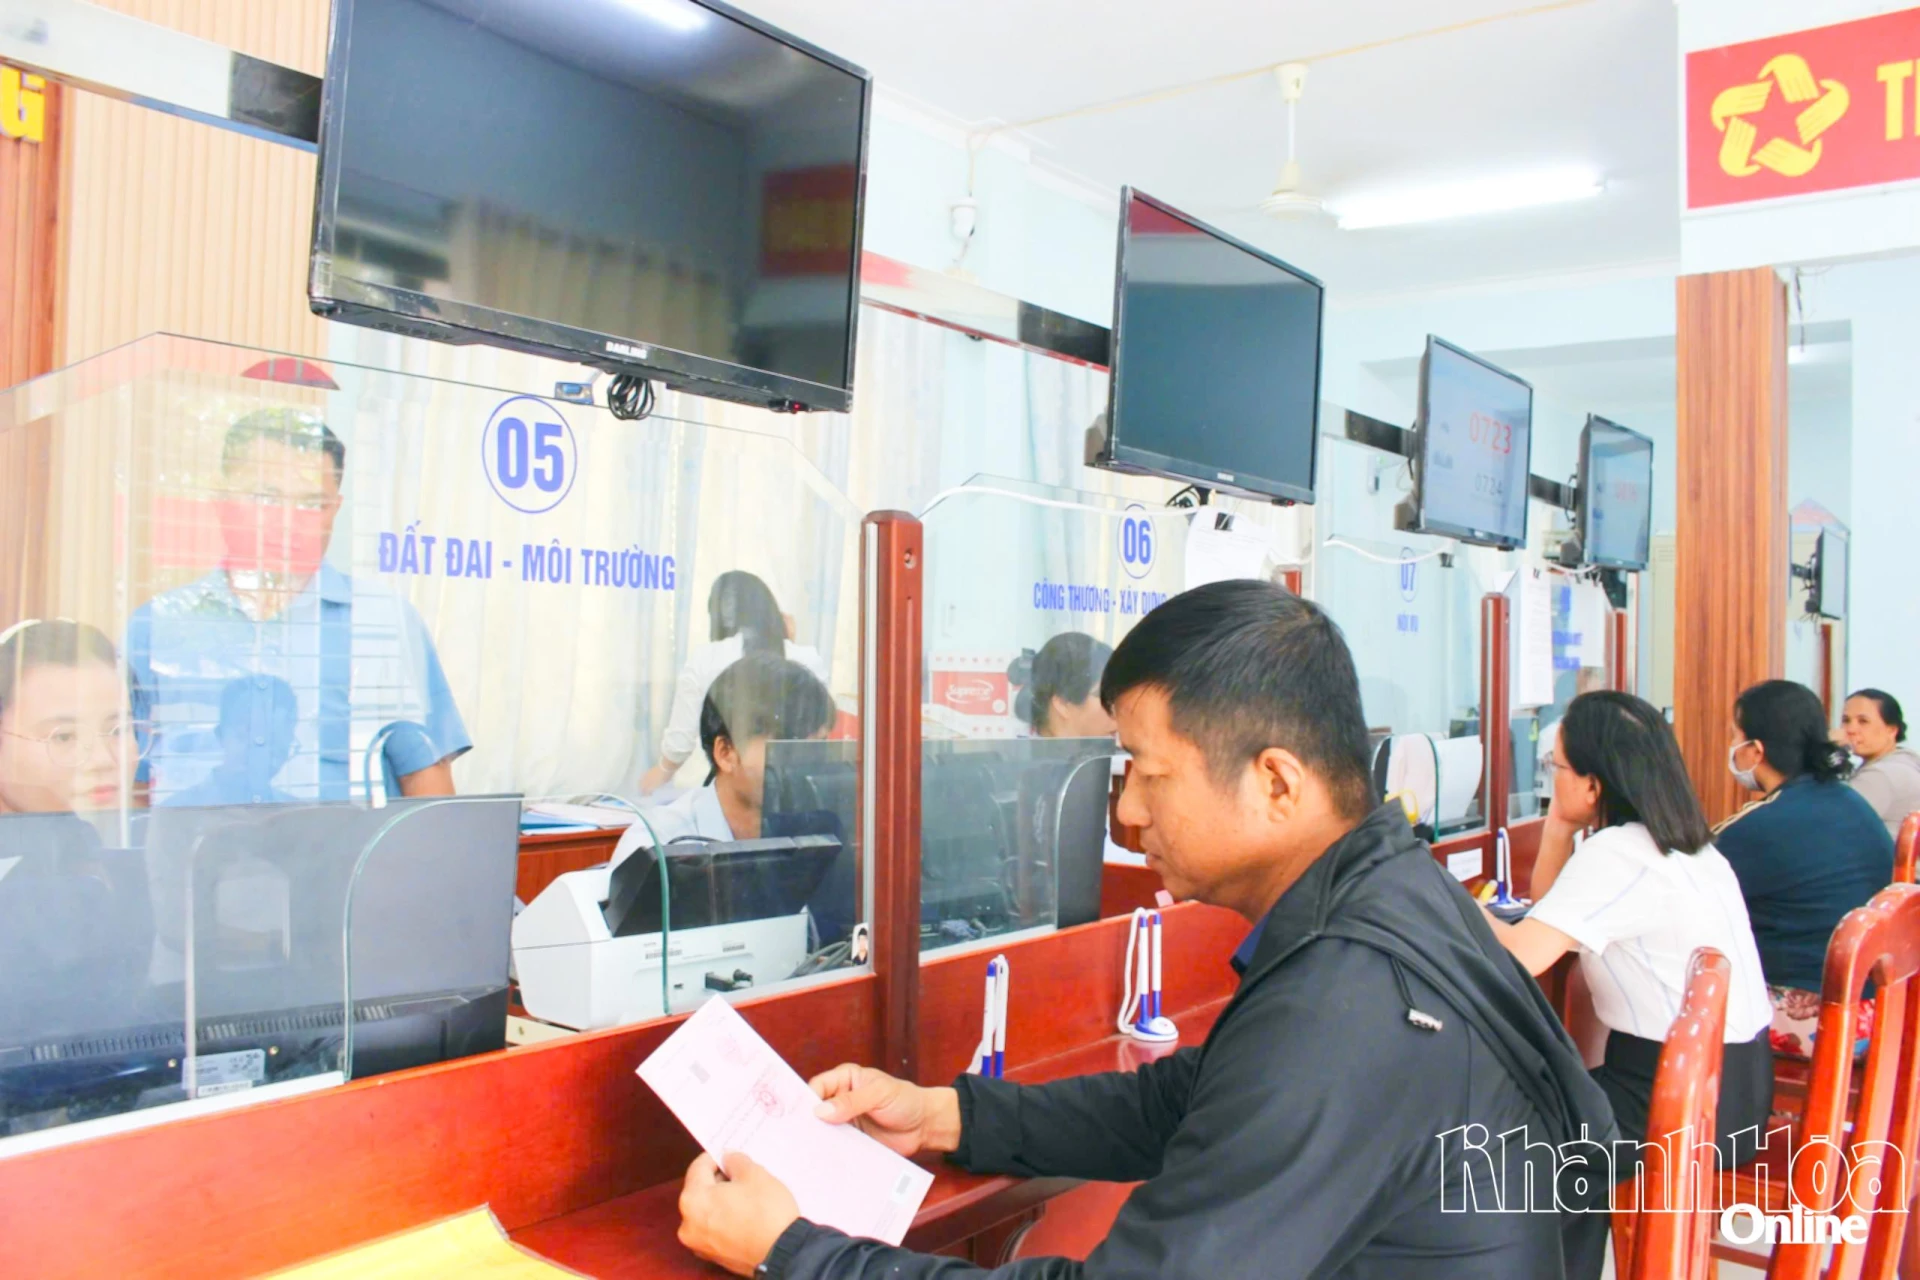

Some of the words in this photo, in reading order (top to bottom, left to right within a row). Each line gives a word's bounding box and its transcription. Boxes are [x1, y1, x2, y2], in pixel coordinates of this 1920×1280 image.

[1876, 59, 1920, 141] T
[496, 416, 564, 493] 05
[1468, 411, 1513, 455] 0723
[378, 520, 437, 576] ĐẤT
[445, 537, 493, 579] ĐAI
[503, 559, 513, 569] -
[521, 538, 572, 584] MÔI
[580, 544, 676, 591] TRƯỜNG
[1124, 517, 1151, 564] 06
[1033, 577, 1065, 610] CÔNG
[1067, 584, 1110, 613] THƯƠNG
[1119, 585, 1139, 615] XÂY
